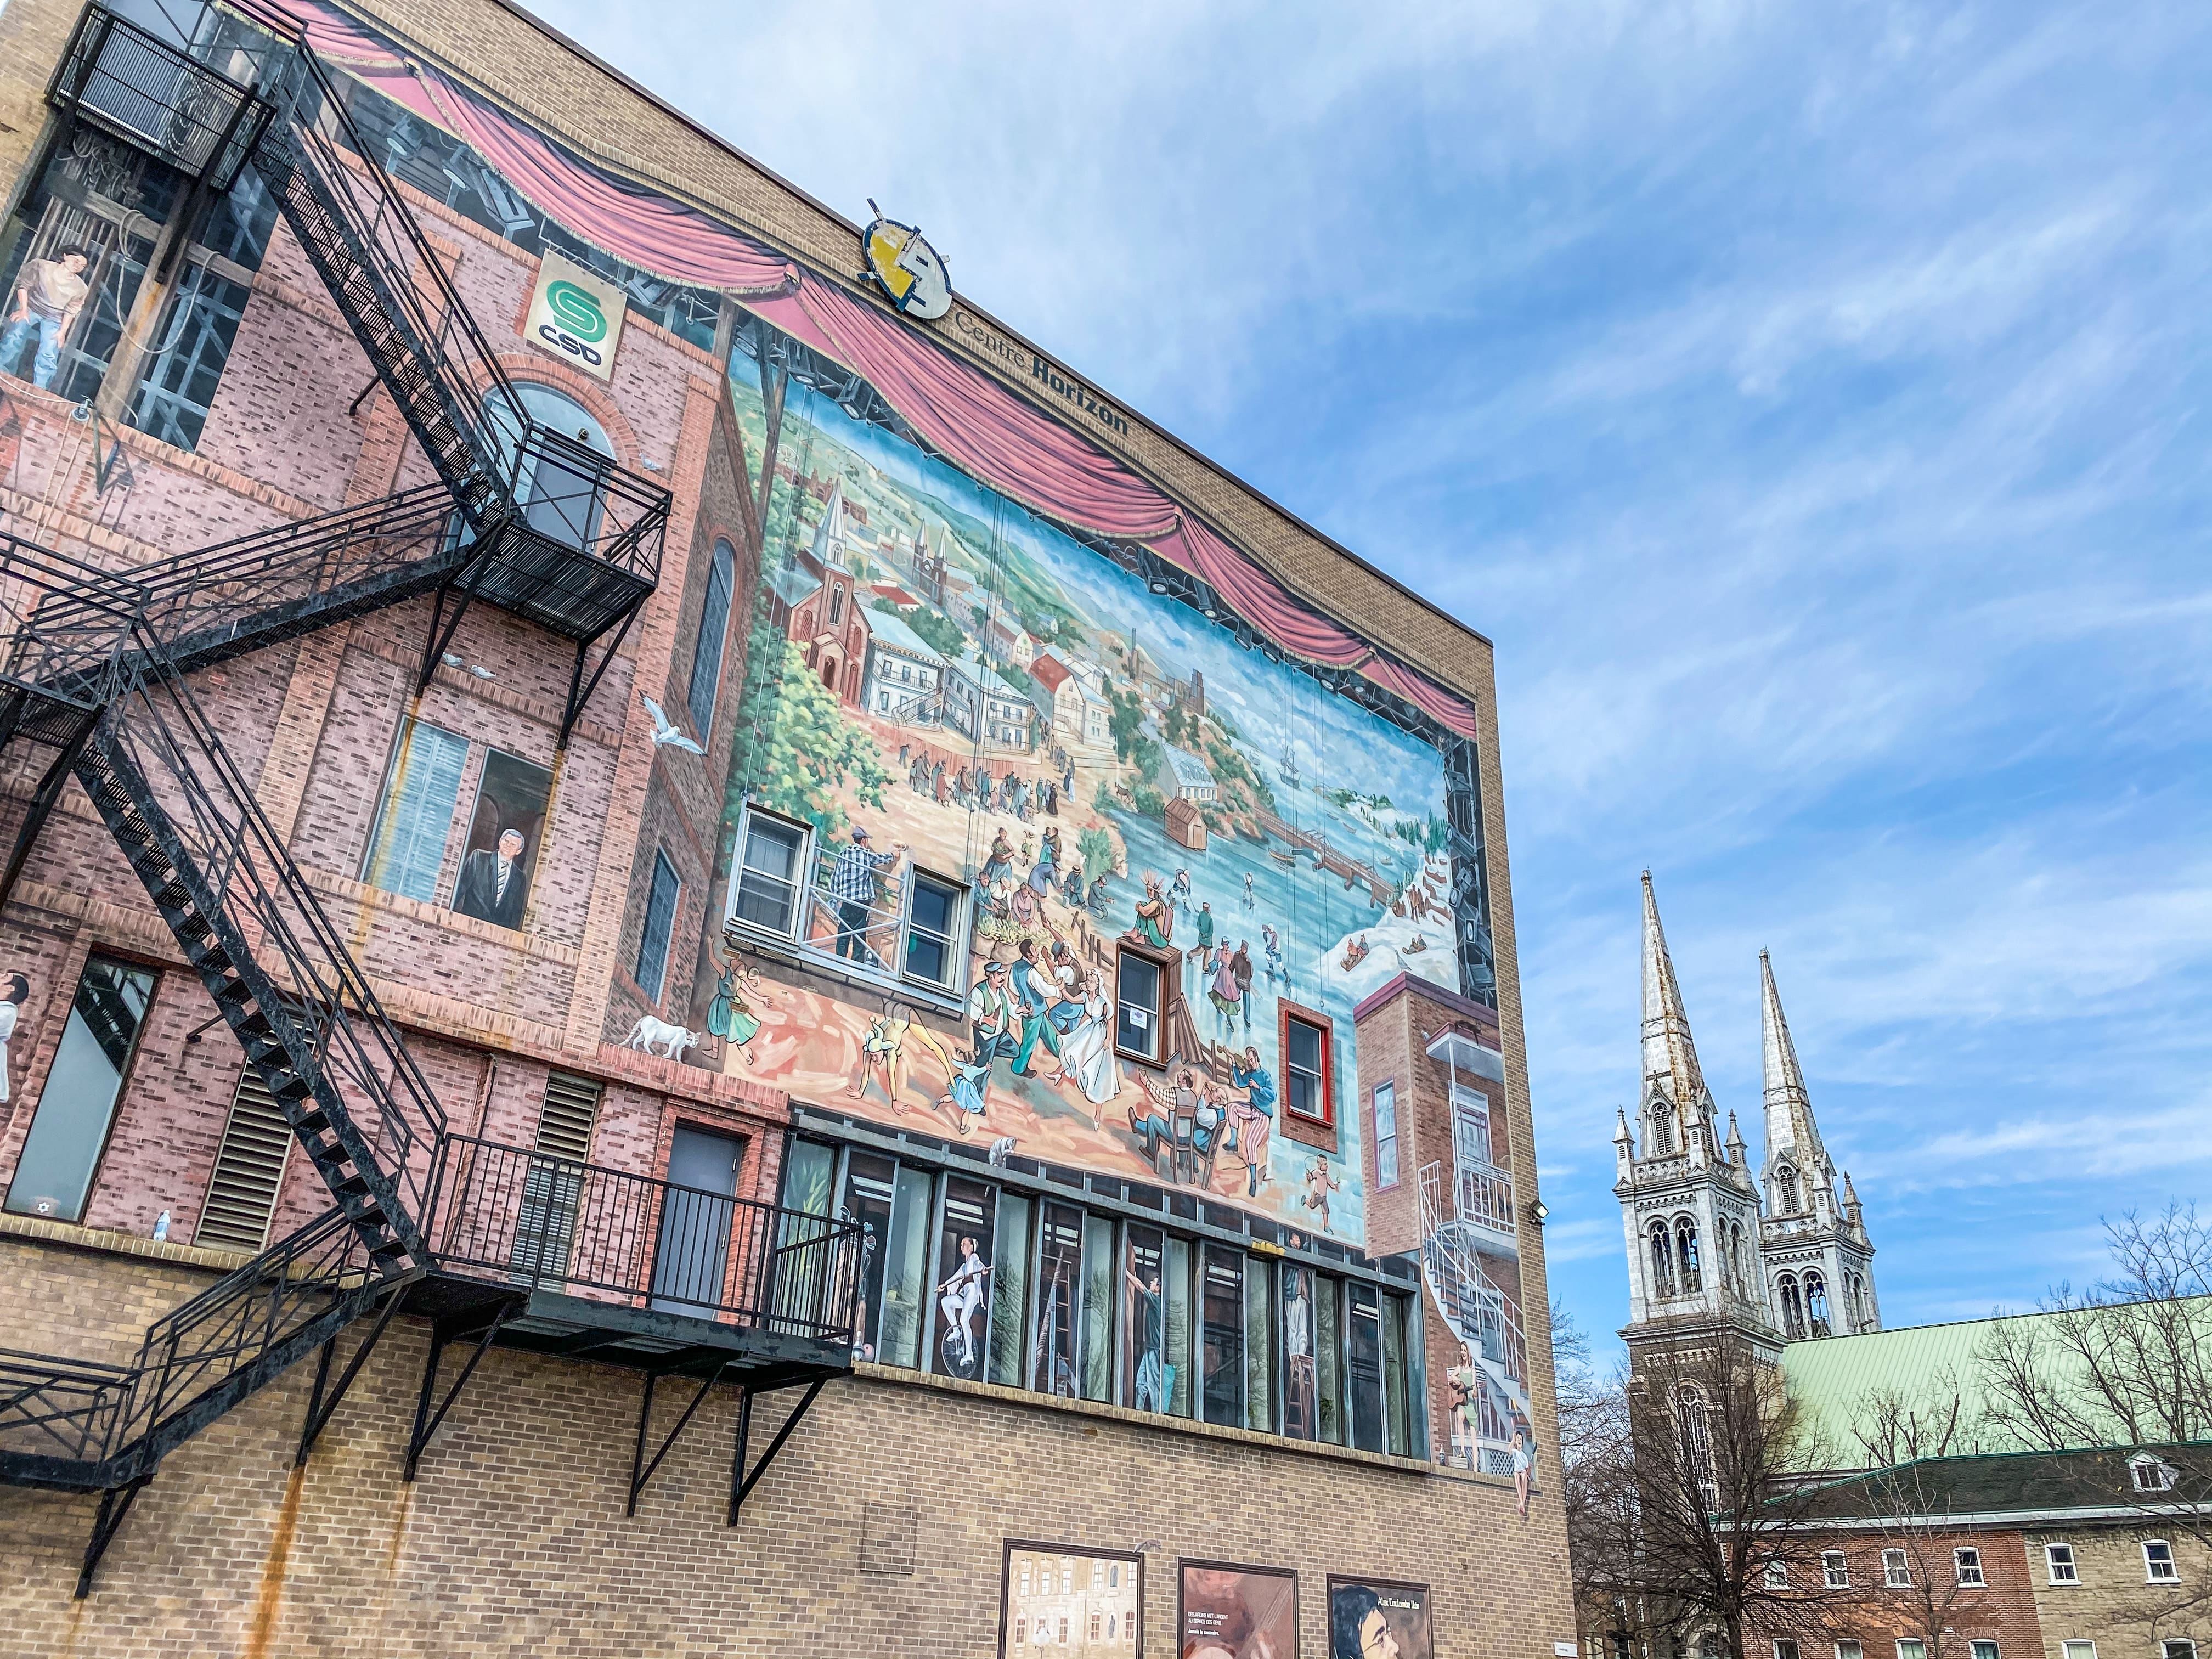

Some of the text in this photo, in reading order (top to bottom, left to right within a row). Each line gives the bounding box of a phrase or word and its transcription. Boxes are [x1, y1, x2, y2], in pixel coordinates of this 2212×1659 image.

[539, 324, 602, 366] CSD
[955, 311, 1128, 437] Centre Horizon
[1378, 1597, 1389, 1606] Alex
[1389, 1598, 1410, 1608] Coulombe
